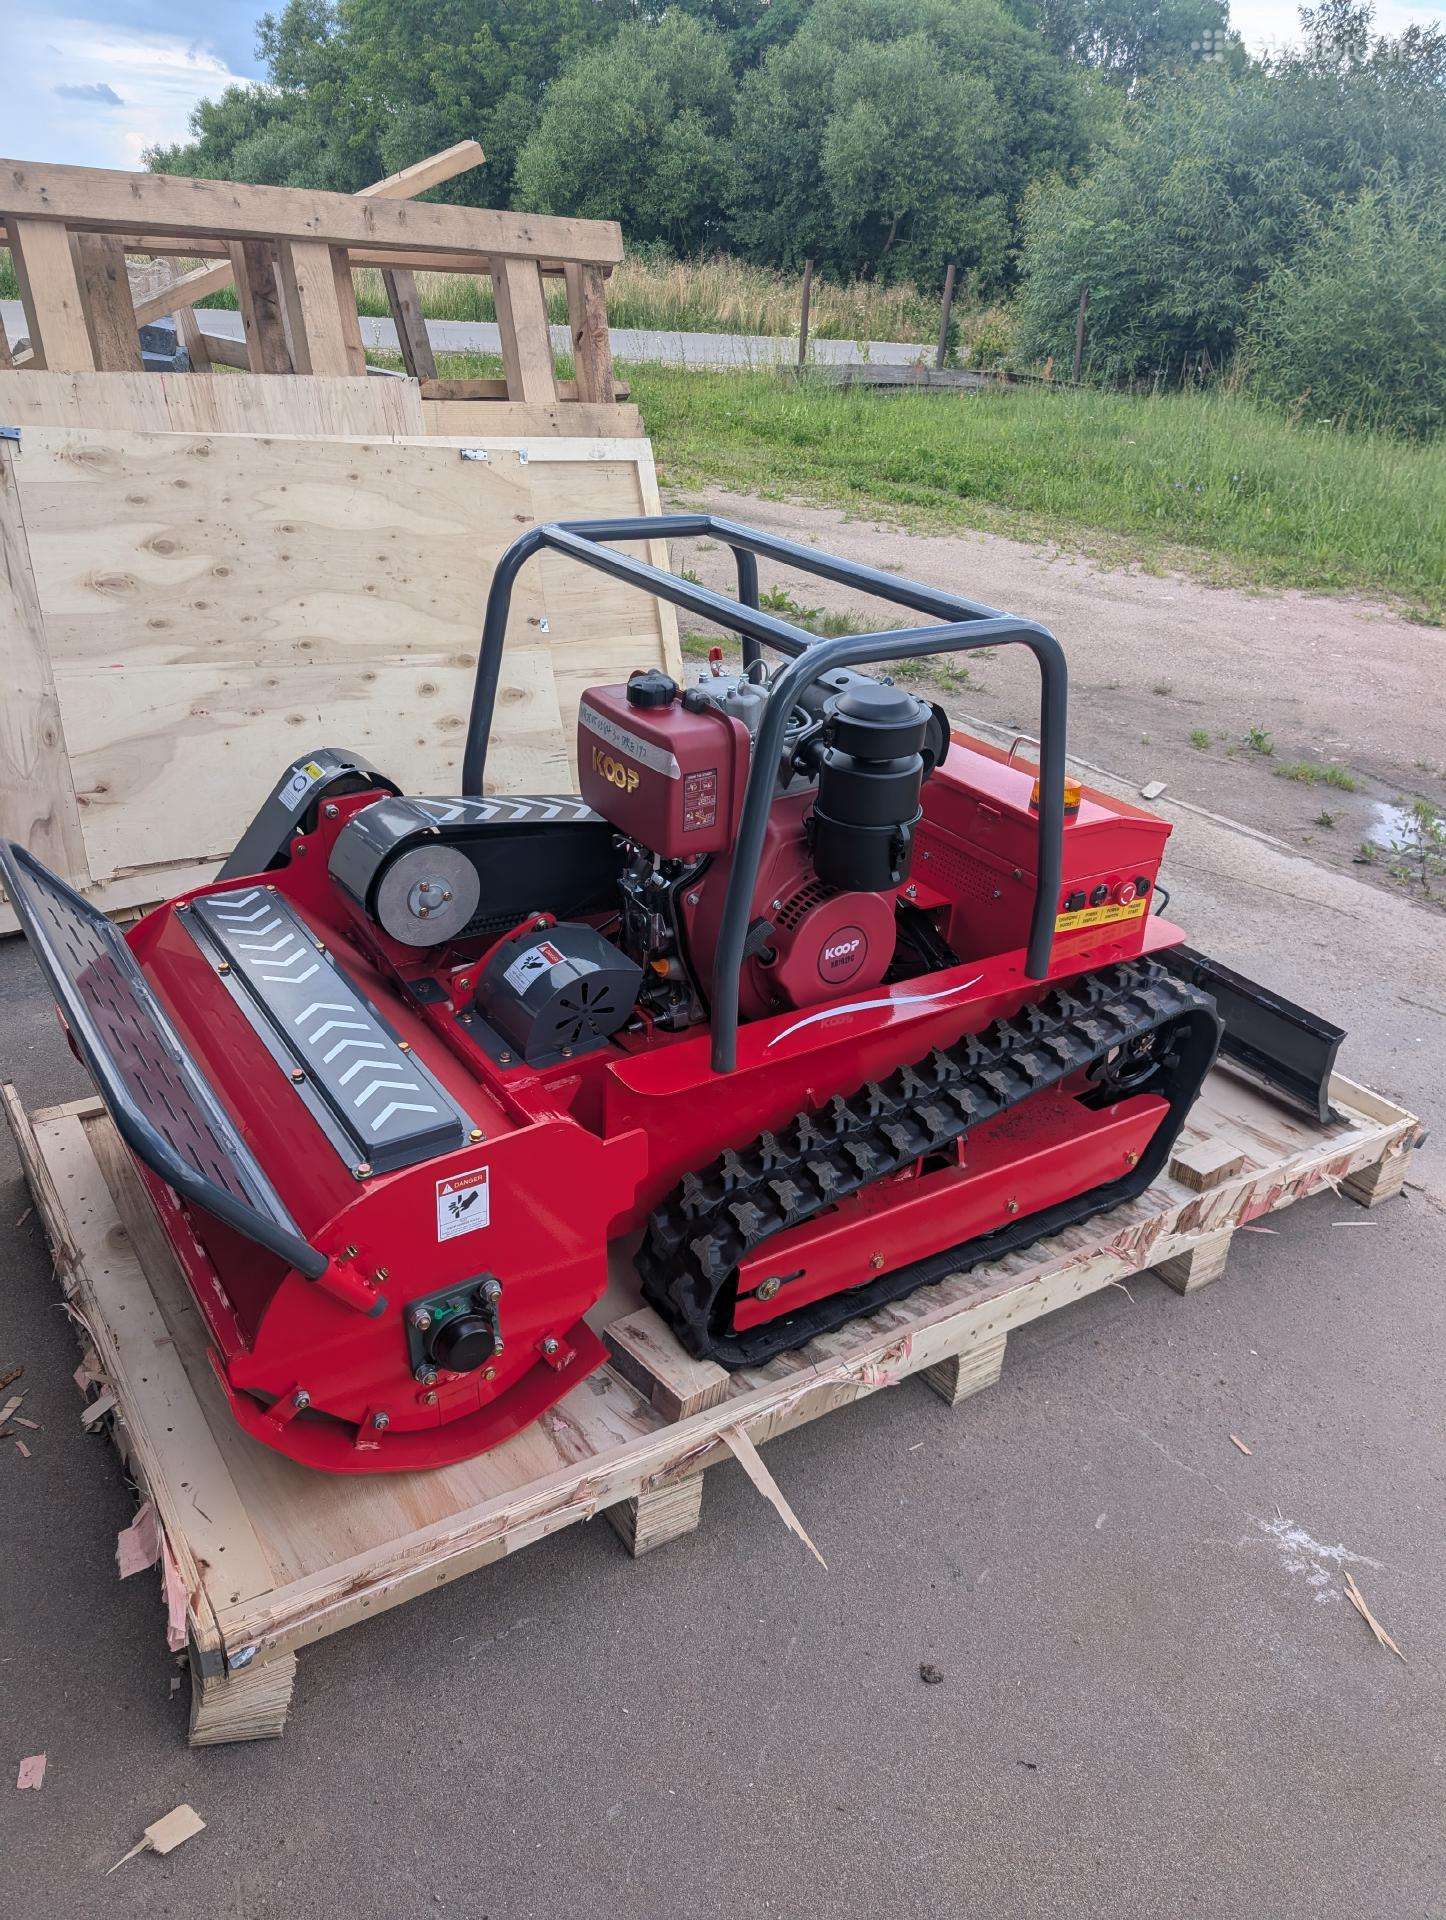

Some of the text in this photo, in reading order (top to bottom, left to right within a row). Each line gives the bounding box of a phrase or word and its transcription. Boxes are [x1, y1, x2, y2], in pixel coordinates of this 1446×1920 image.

[592, 746, 640, 793] KOOP
[825, 939, 860, 960] KOOP
[454, 1175, 483, 1188] DANGER
